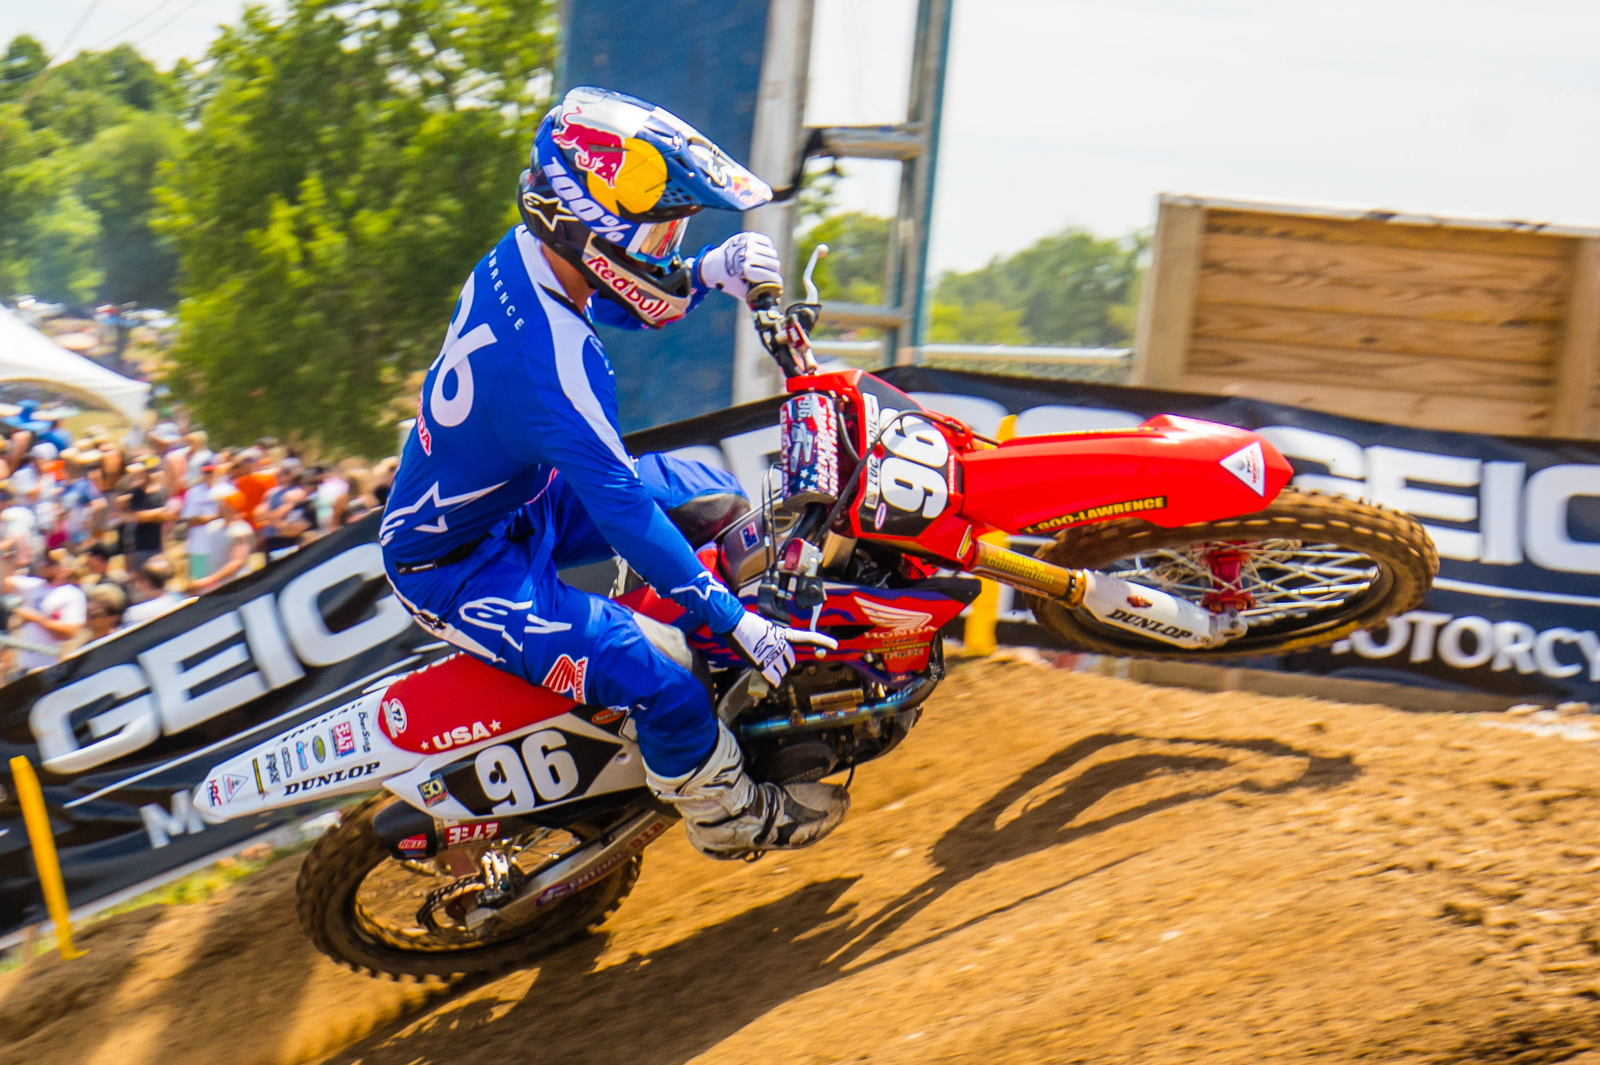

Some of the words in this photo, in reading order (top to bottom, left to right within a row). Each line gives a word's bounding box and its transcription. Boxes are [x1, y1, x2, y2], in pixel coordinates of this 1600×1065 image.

[543, 157, 632, 243] 100%
[880, 407, 948, 519] 96
[1024, 496, 1165, 534] 1-800-LAWRENCE
[863, 625, 939, 639] HONDA
[1106, 608, 1194, 640] DUNLOP
[1331, 610, 1600, 682] OTORCY
[432, 721, 491, 750] USA
[283, 760, 381, 797] DUNLOP
[474, 729, 579, 815] 96
